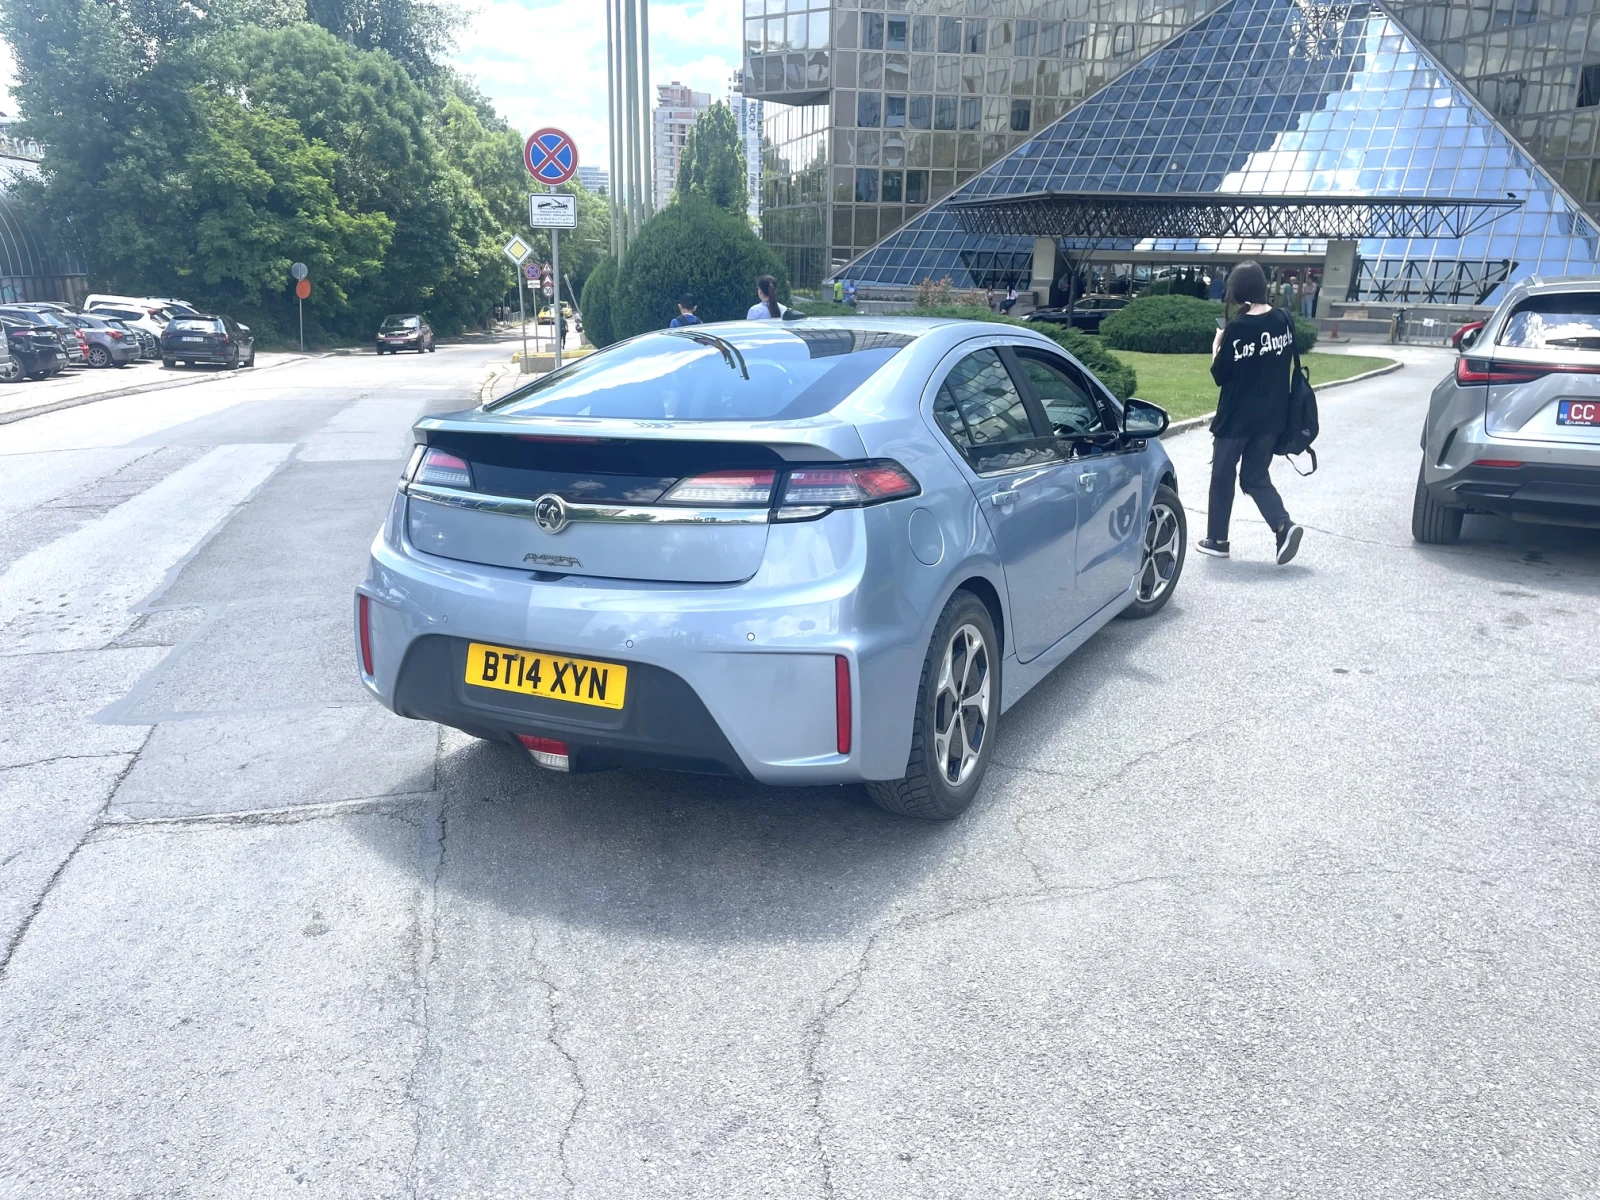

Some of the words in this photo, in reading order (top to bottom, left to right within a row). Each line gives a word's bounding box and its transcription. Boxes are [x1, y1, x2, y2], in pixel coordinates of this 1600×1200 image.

[749, 102, 757, 125] ROCK
[1233, 339, 1255, 361] Los
[1571, 404, 1595, 420] CC
[482, 650, 541, 689] BT14
[550, 661, 608, 700] XYN
